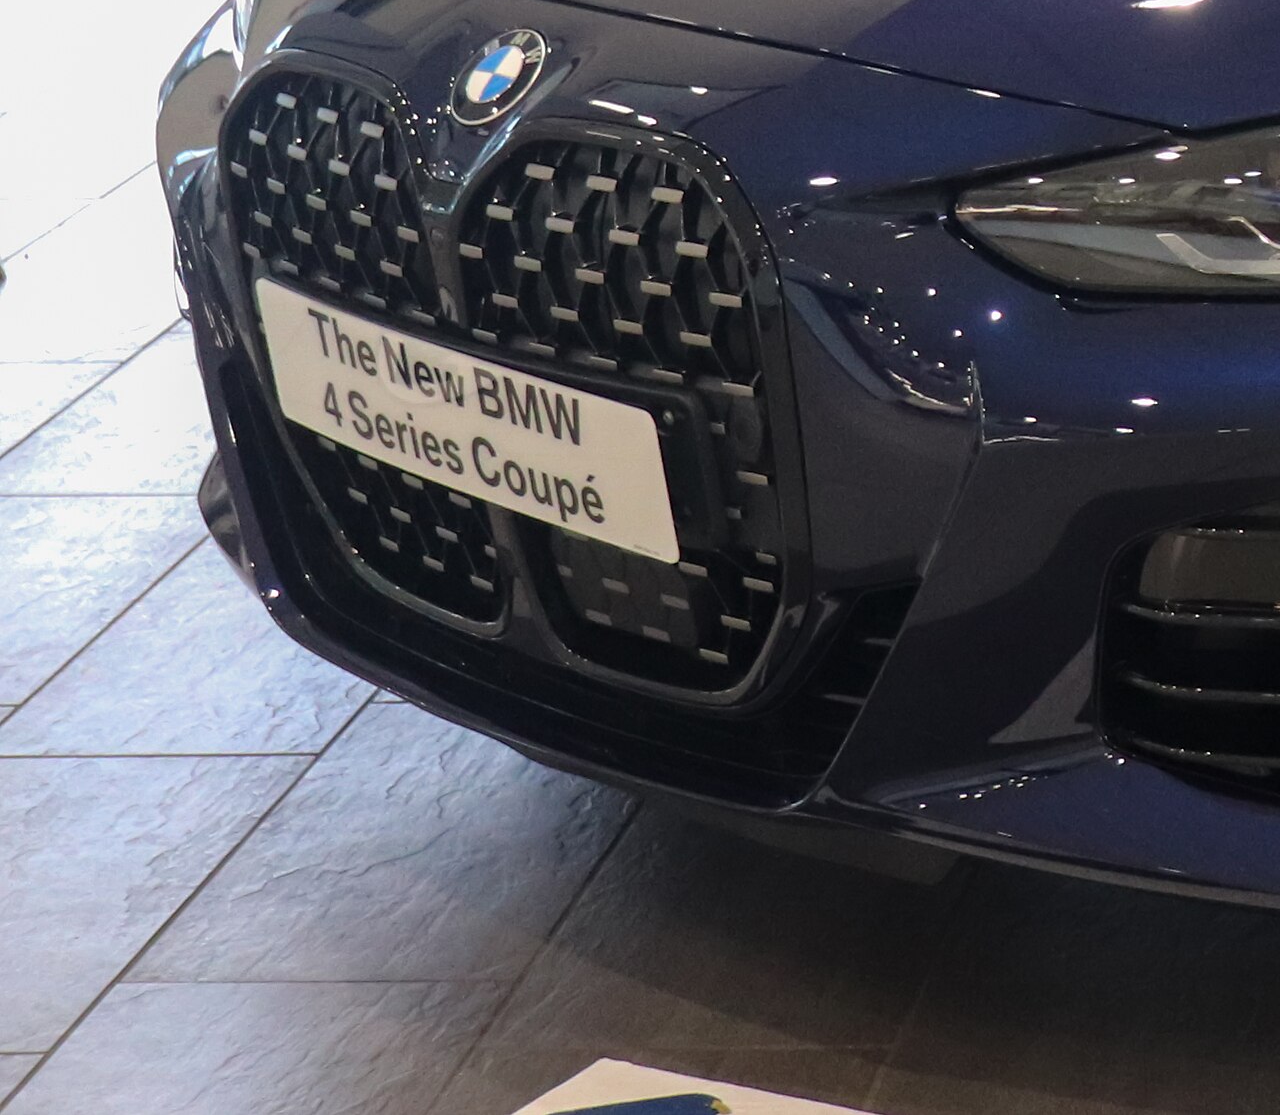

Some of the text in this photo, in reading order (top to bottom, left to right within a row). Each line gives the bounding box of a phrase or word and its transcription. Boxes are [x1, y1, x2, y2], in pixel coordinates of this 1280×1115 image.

[307, 308, 581, 446] The New BMW
[323, 381, 606, 524] 4 Series Coupé
